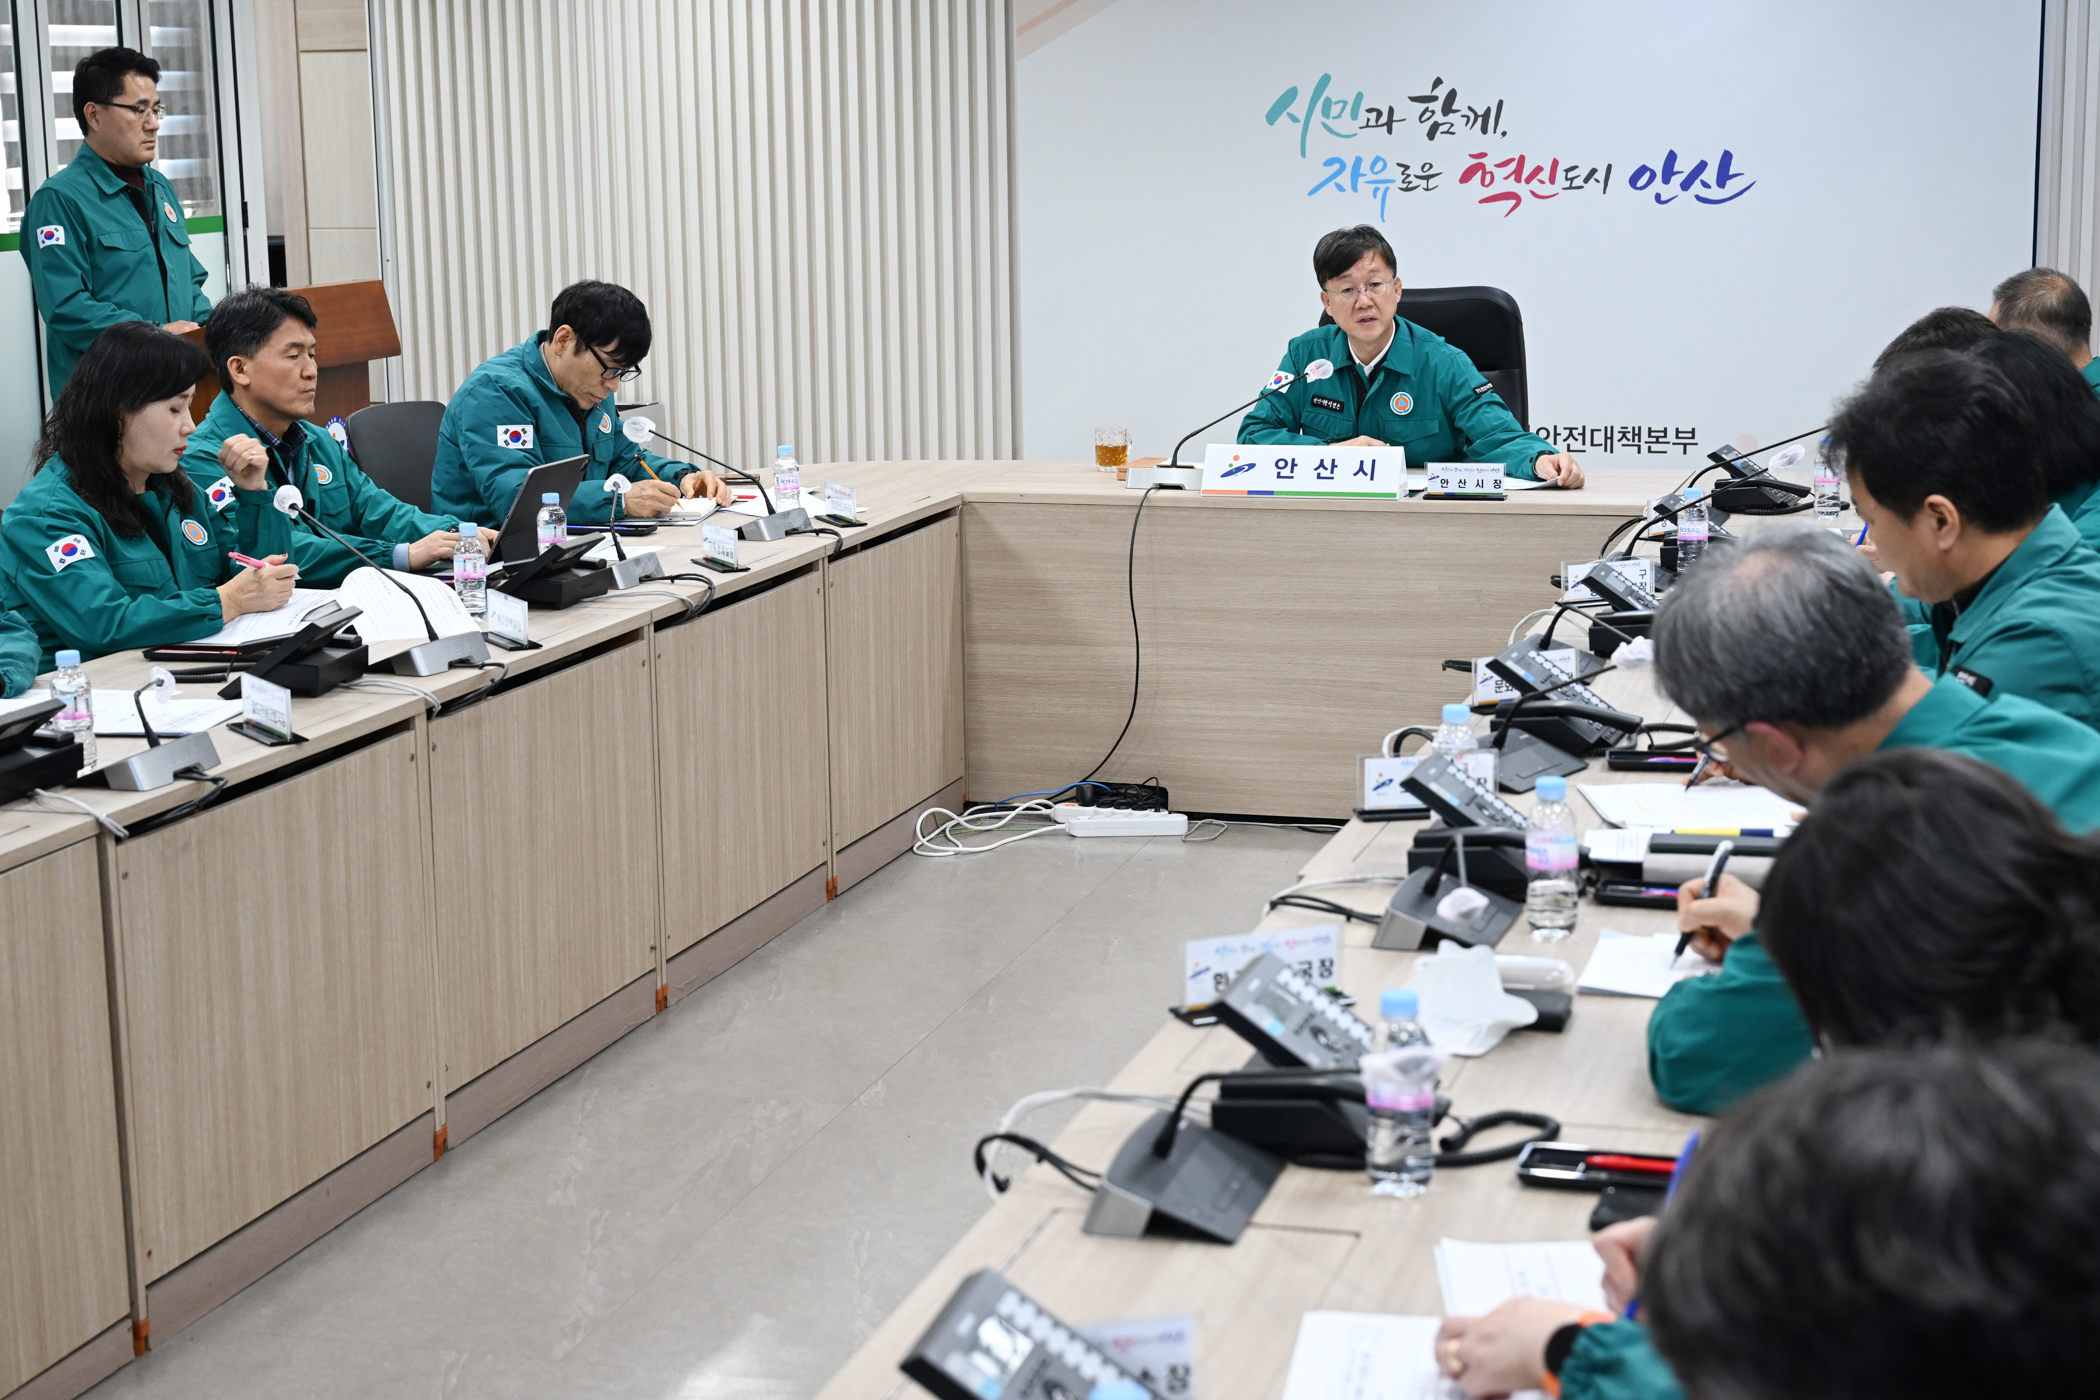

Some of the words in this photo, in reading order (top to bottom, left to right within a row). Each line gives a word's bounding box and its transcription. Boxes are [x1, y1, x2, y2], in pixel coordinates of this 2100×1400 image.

[1265, 73, 1406, 158] 시민과
[1308, 155, 1443, 223] 자유로운
[1459, 151, 1612, 218] 혁신도시
[1628, 149, 1756, 205] 안산
